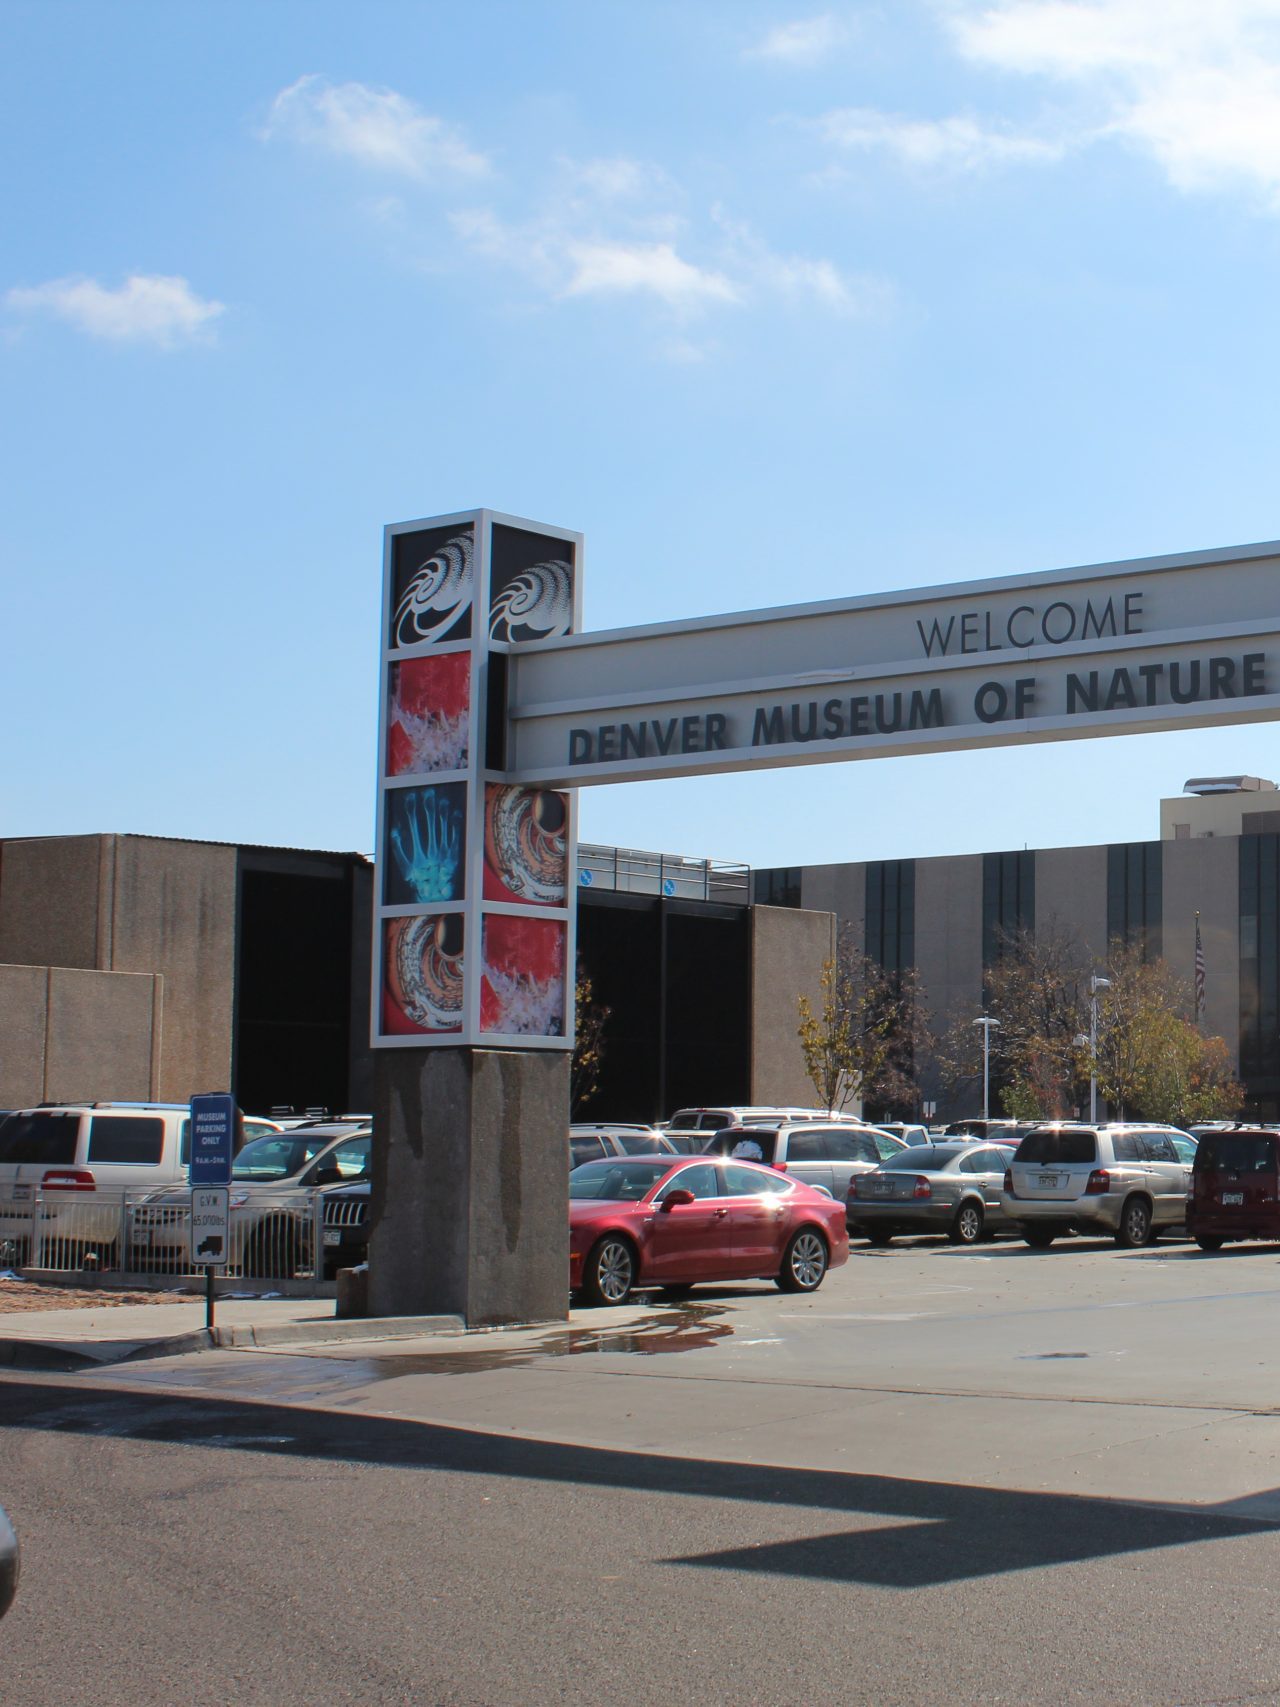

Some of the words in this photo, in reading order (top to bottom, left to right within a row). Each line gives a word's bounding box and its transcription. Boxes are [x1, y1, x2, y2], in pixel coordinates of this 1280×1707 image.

[916, 592, 1144, 659] WELCOME
[569, 712, 729, 766] DENVER
[751, 687, 945, 747] MUSEUM
[973, 677, 1036, 724] OF
[1066, 652, 1267, 715] NATURE
[197, 1112, 226, 1121] MUSEUM
[196, 1124, 226, 1133] PARKING
[201, 1136, 220, 1145] ONLY
